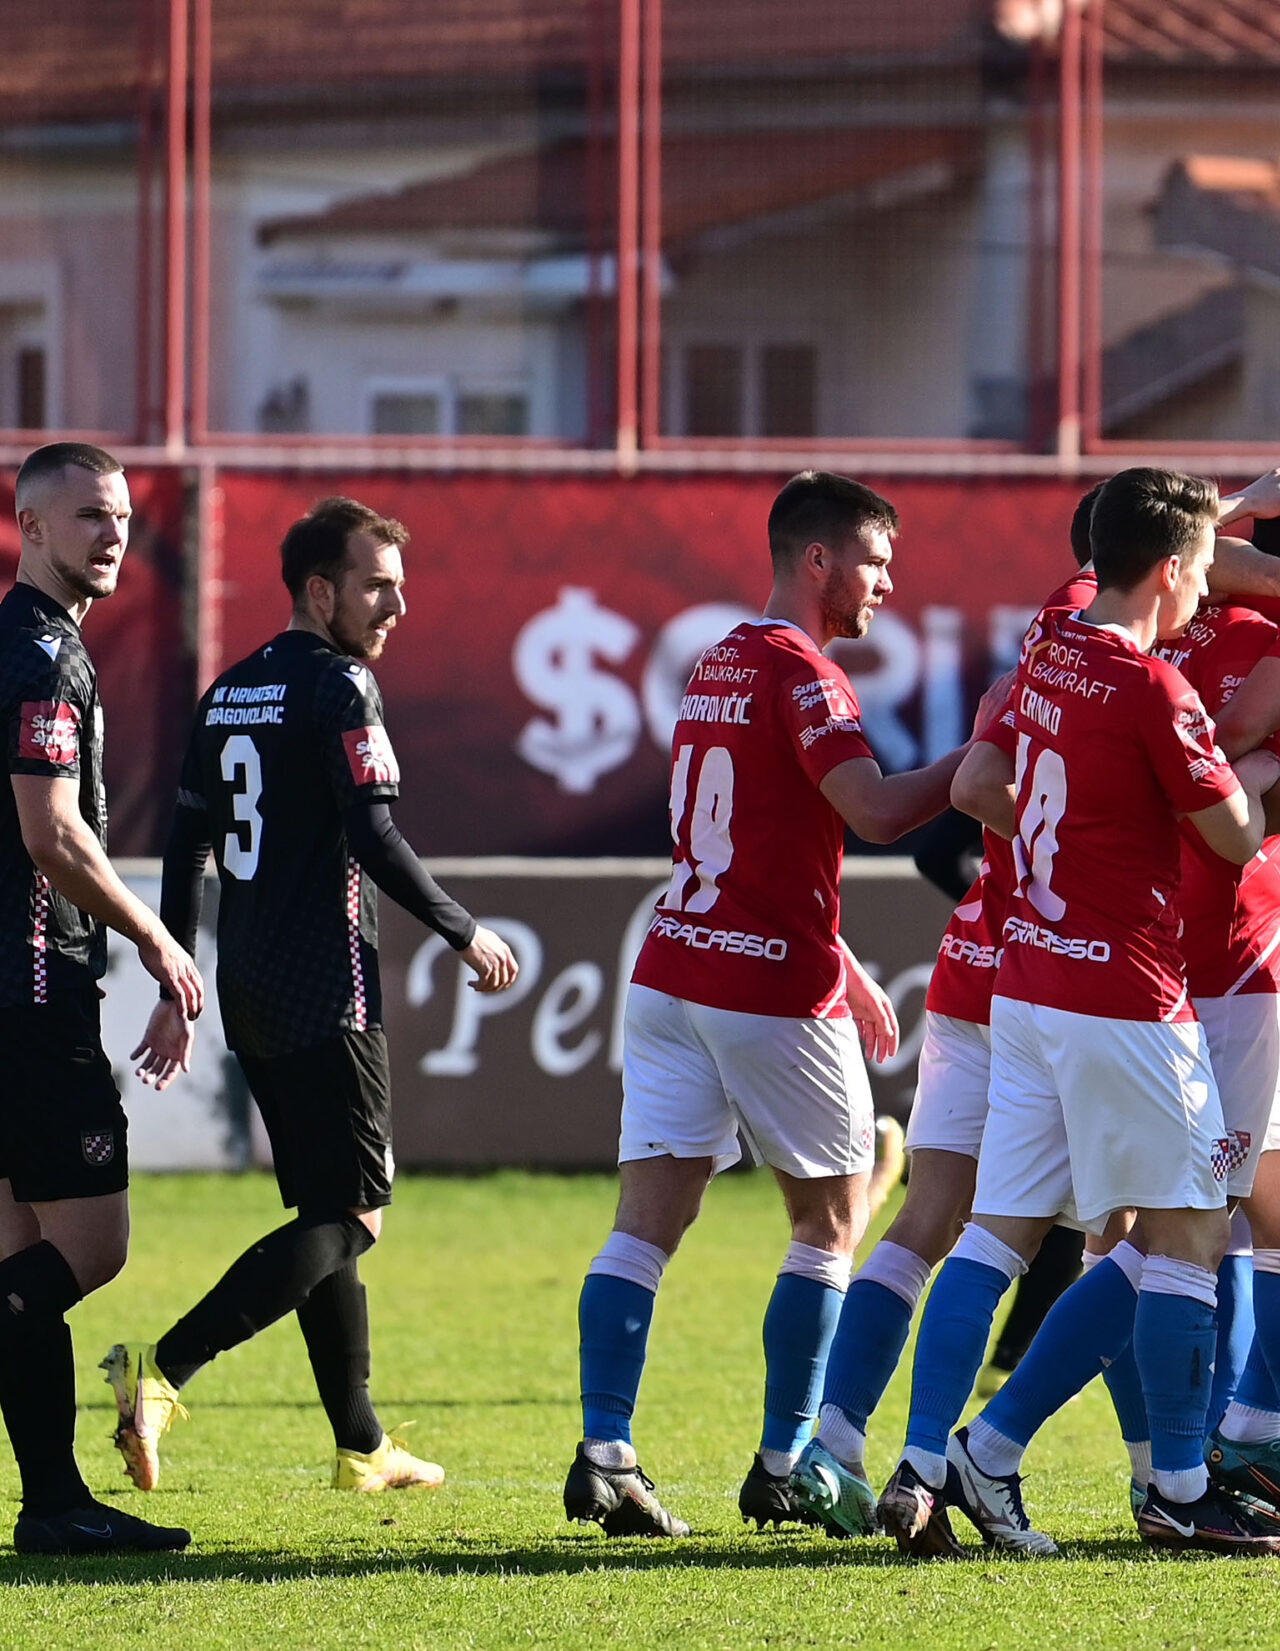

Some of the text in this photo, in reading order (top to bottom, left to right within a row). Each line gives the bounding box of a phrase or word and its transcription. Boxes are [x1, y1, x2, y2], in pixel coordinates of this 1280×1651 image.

[703, 665, 758, 685] BAUKRAFT
[1047, 643, 1088, 669] ROFI-
[1032, 661, 1118, 705] BAUKRAFT
[220, 735, 263, 881] 3
[652, 916, 788, 961] FRACASSO
[938, 933, 1004, 969] ACASS
